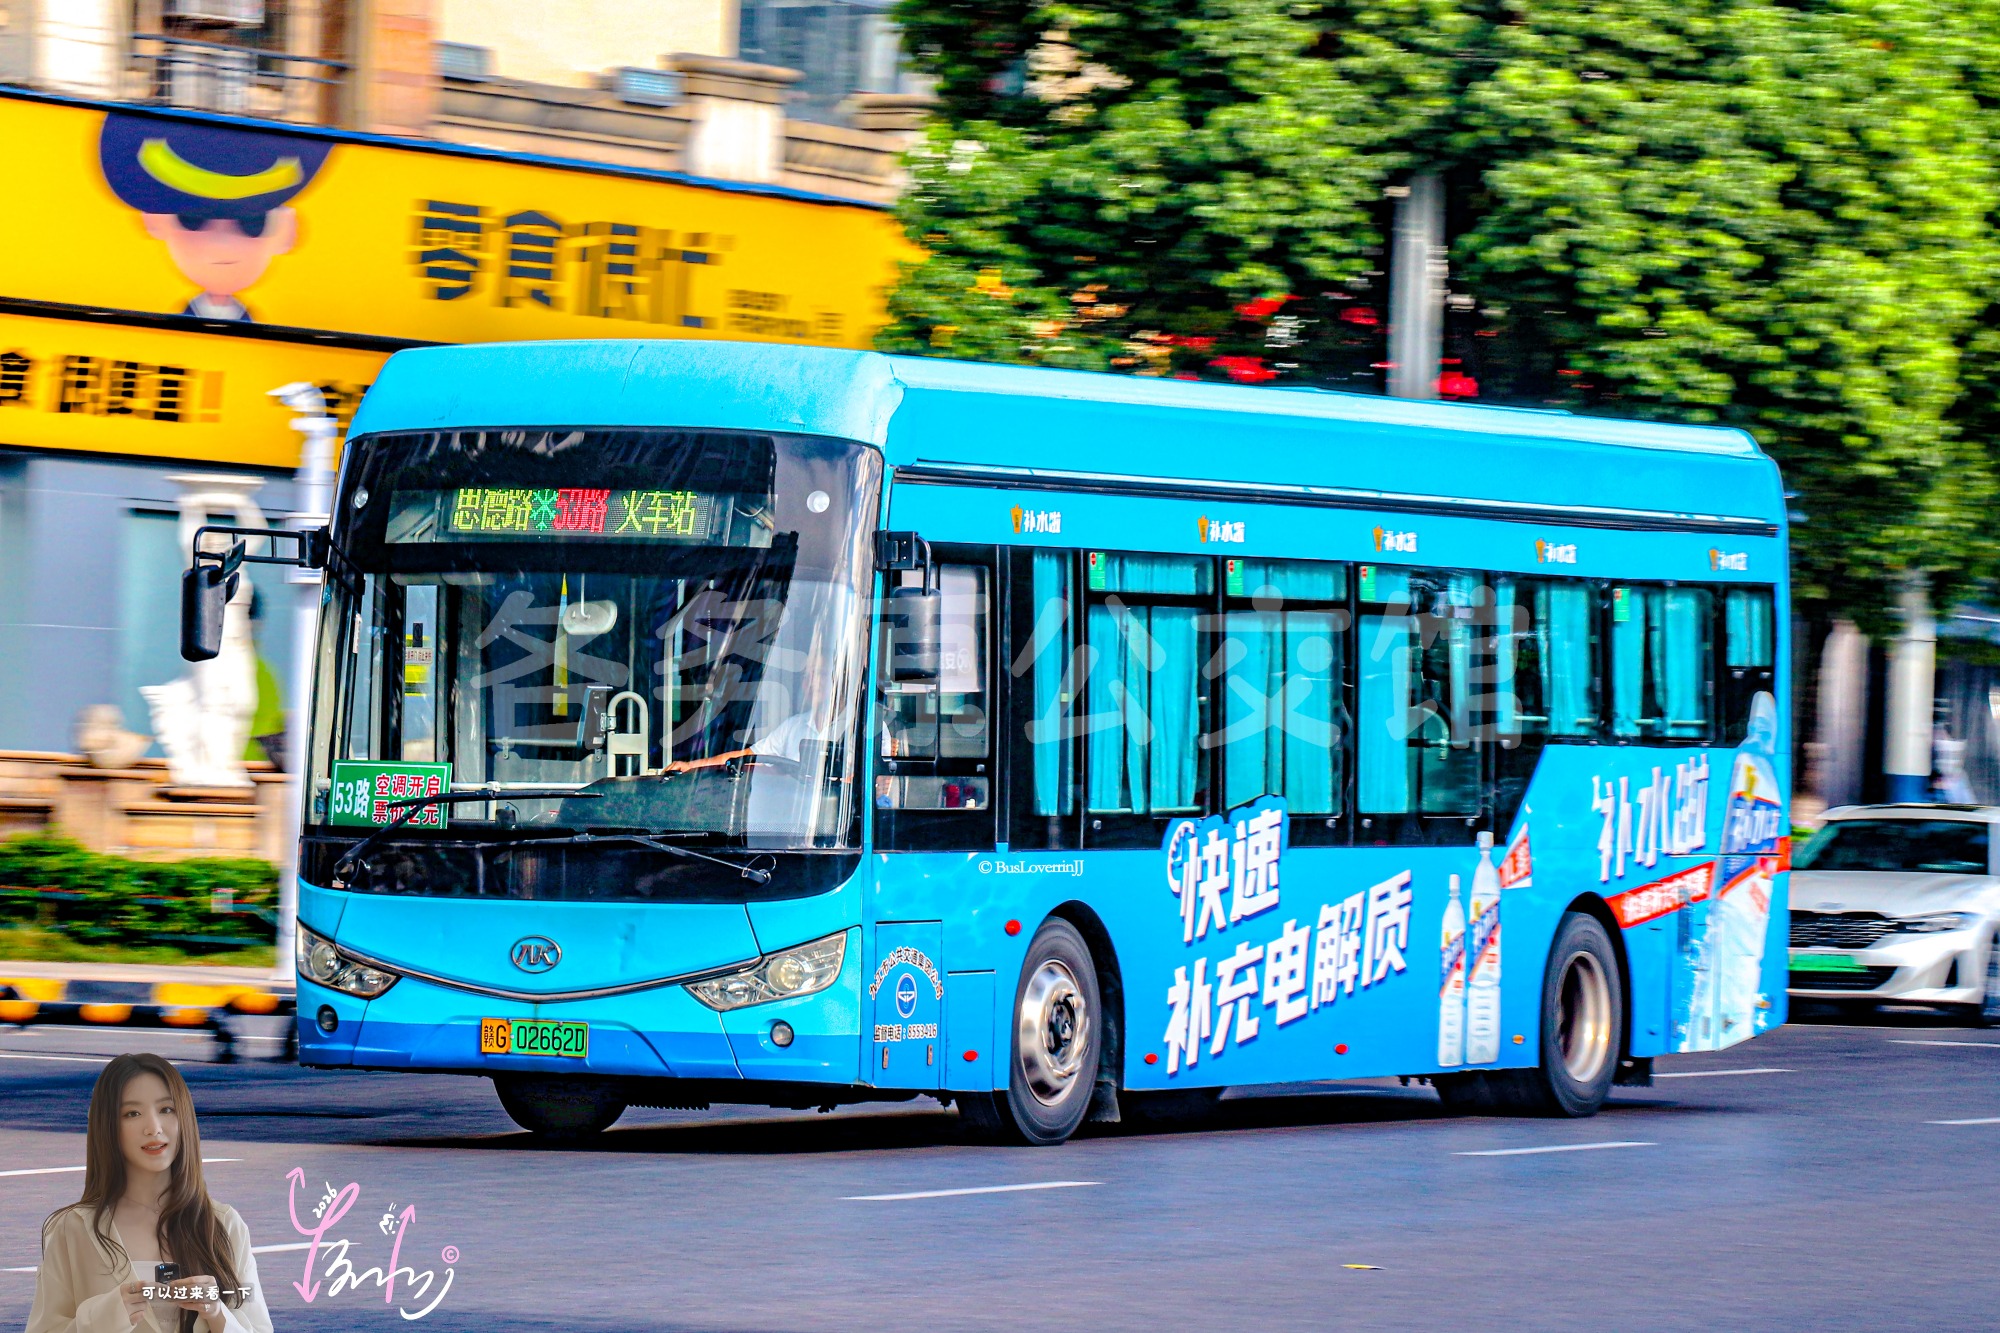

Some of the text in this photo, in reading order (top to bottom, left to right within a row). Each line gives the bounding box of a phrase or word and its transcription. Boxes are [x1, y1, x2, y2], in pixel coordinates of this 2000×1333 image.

[614, 489, 698, 535] 火车站
[335, 778, 371, 819] 53路
[374, 773, 441, 798] 空调开启
[1178, 808, 1283, 944] 快速
[1163, 869, 1413, 1075] 补充电解质
